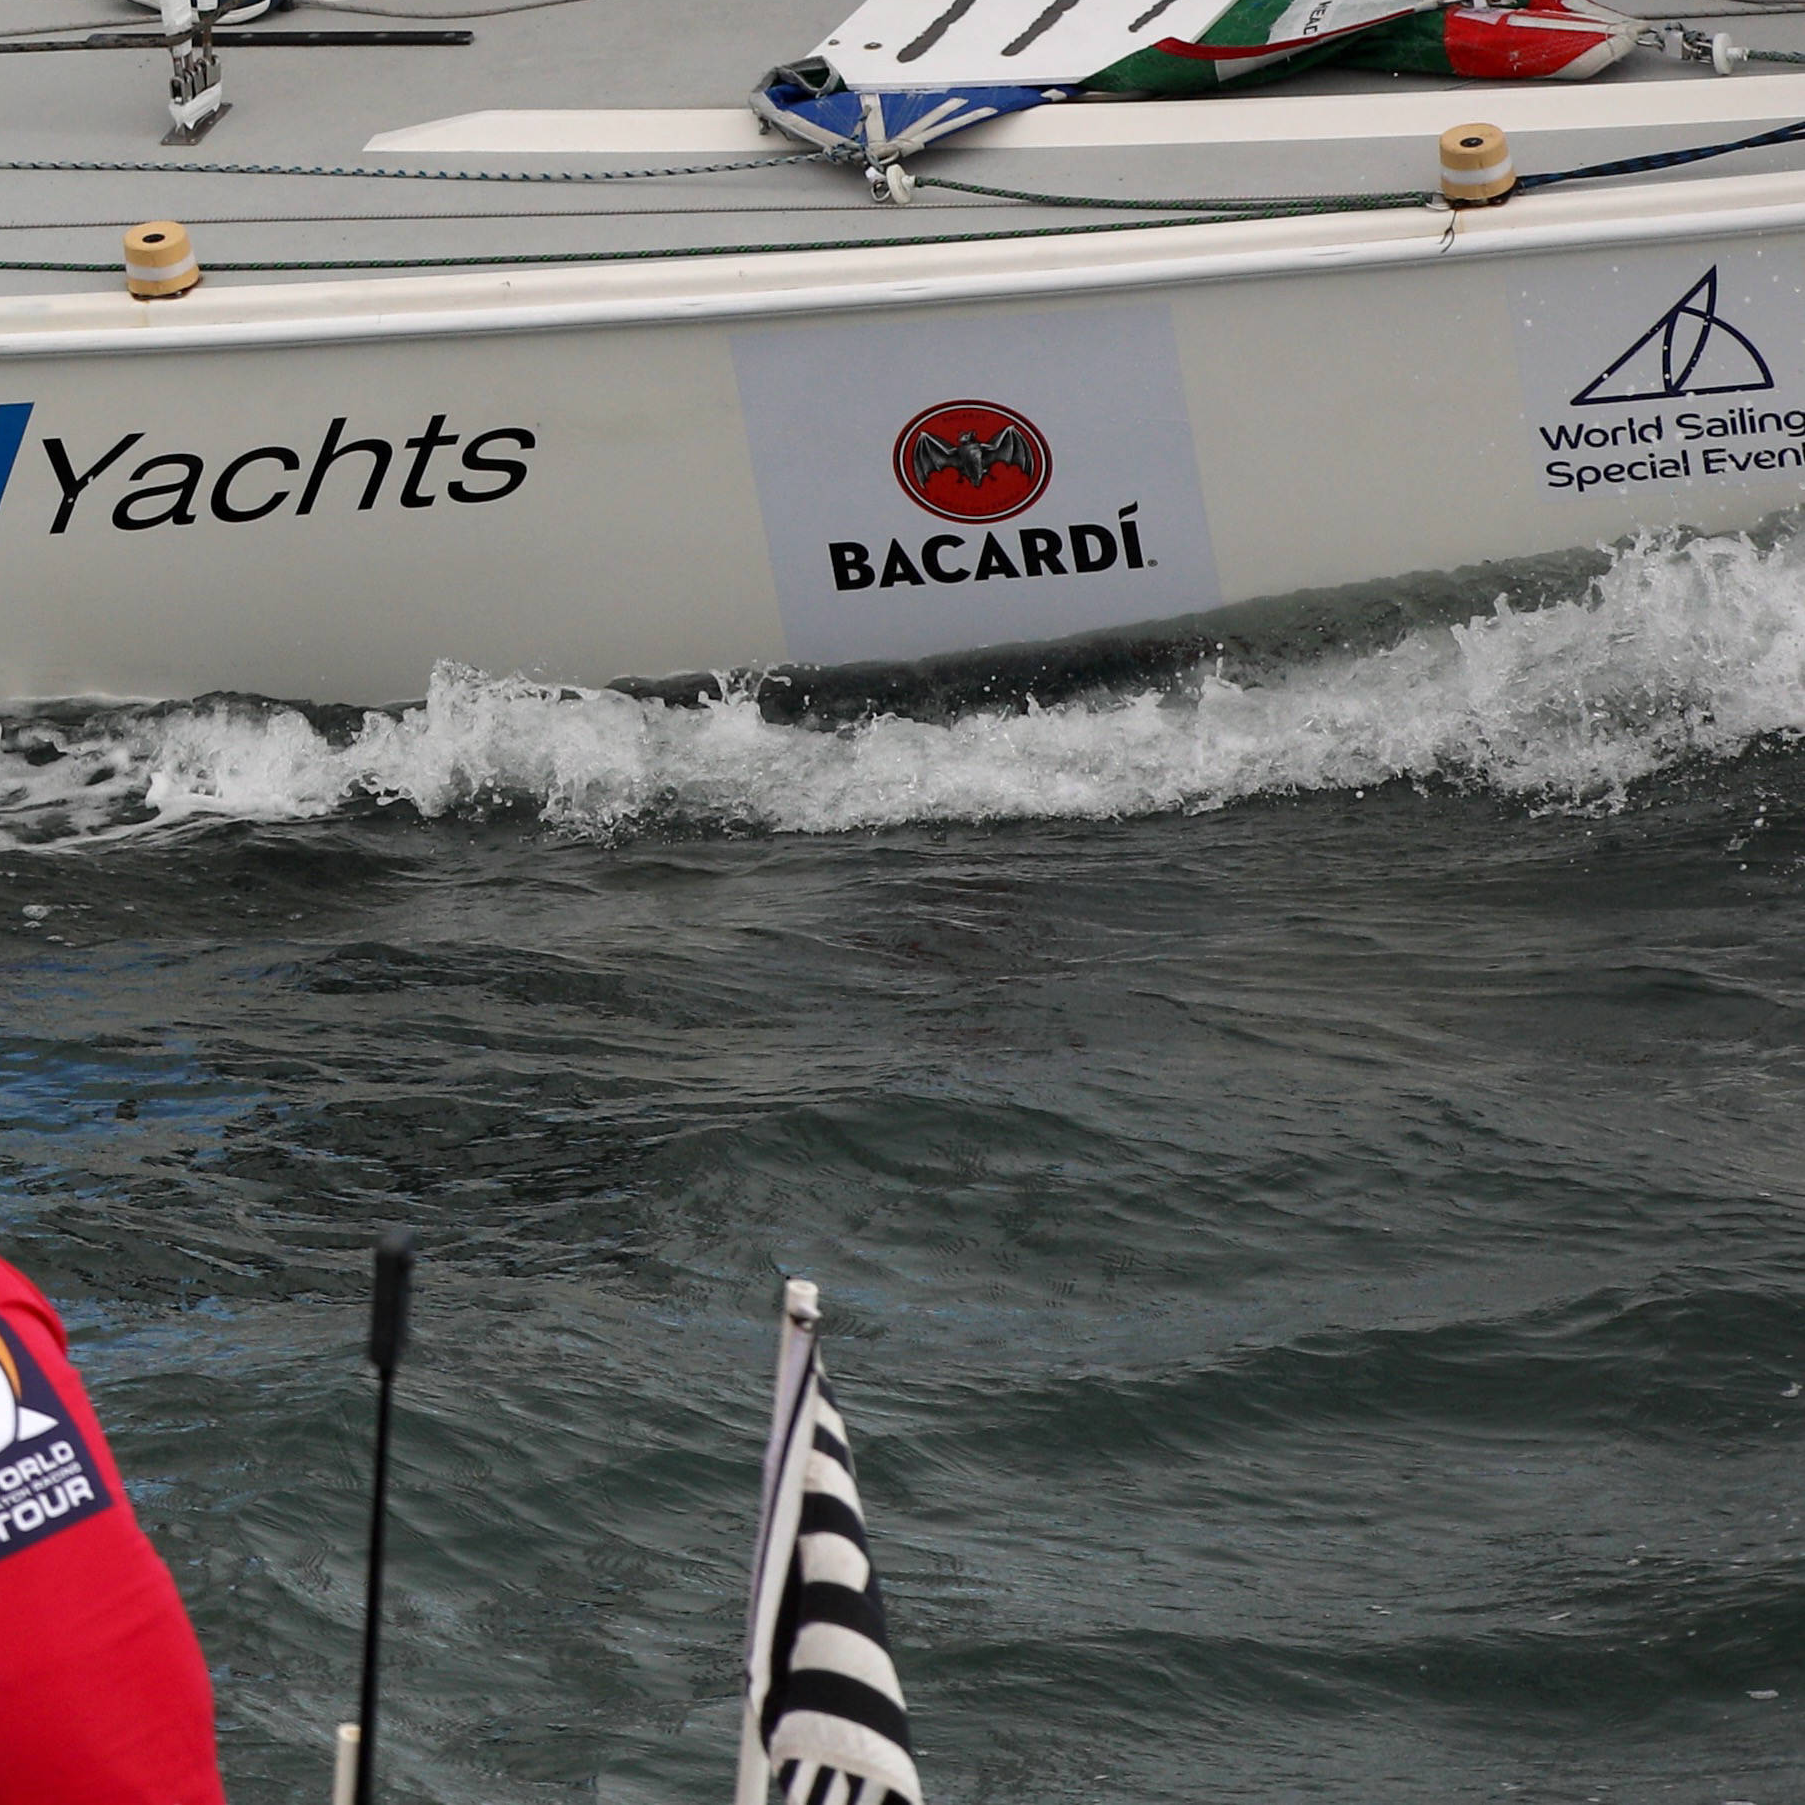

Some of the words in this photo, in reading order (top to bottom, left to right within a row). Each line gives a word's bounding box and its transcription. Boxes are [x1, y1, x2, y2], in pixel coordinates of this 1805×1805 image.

[1539, 414, 1663, 451] World
[1675, 406, 1805, 440] Sailing
[42, 413, 537, 537] Yachts
[1545, 449, 1691, 492] Special
[1702, 442, 1805, 474] Even
[828, 500, 1144, 591] BACARDÍ
